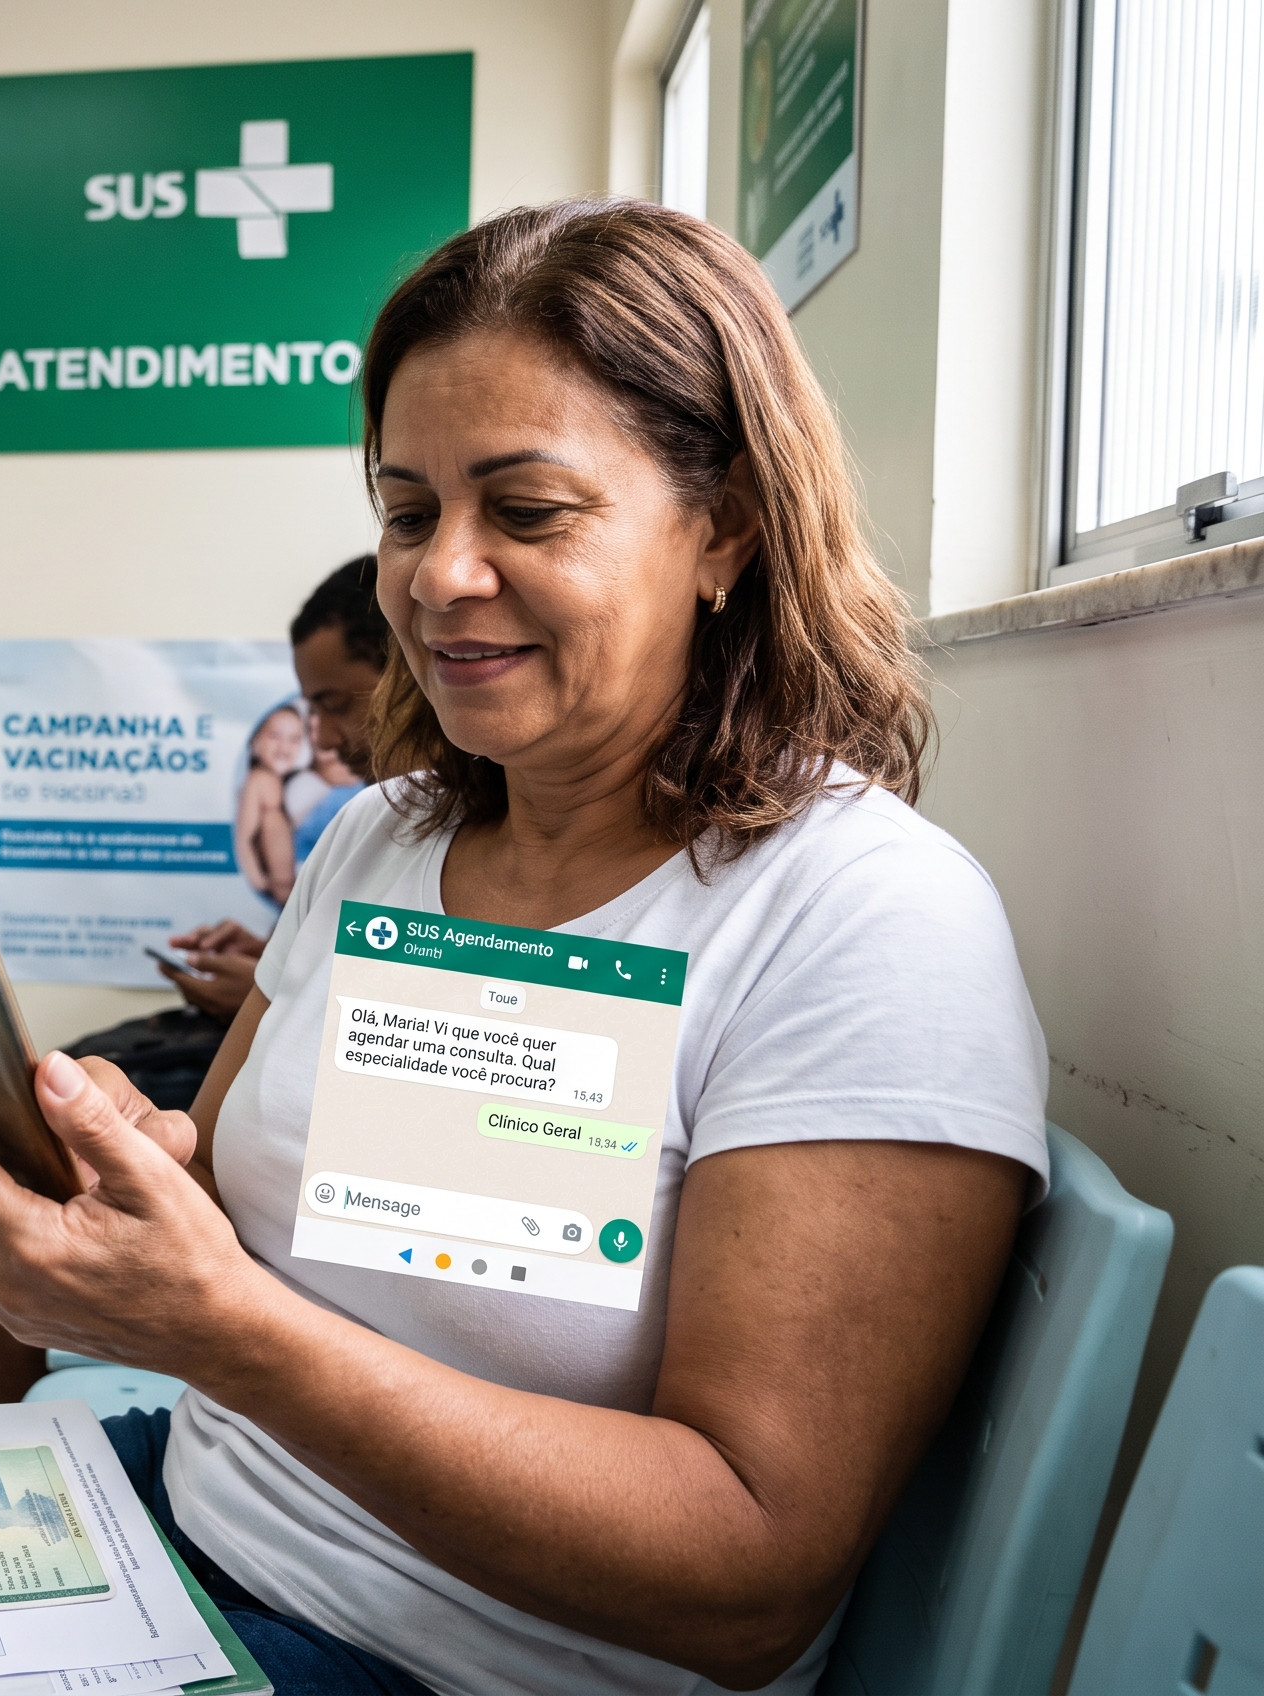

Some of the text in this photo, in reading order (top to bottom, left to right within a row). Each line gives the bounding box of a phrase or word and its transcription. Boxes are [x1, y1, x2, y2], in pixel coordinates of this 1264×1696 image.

[83, 171, 187, 221] SUS
[3, 714, 184, 740] CAMPANHA
[3, 743, 209, 778] VACINAÇÃOS
[406, 922, 554, 957] SUS Agendamento
[488, 990, 518, 1005] Toue
[351, 1008, 557, 1053] Olá, Maria! Vi que você quer
[348, 1030, 557, 1072] agendar uma consulta. Qual
[345, 1049, 556, 1092] especialidade você procura?
[488, 1113, 582, 1140] Clínico Geral
[346, 1190, 421, 1218] Mensage
